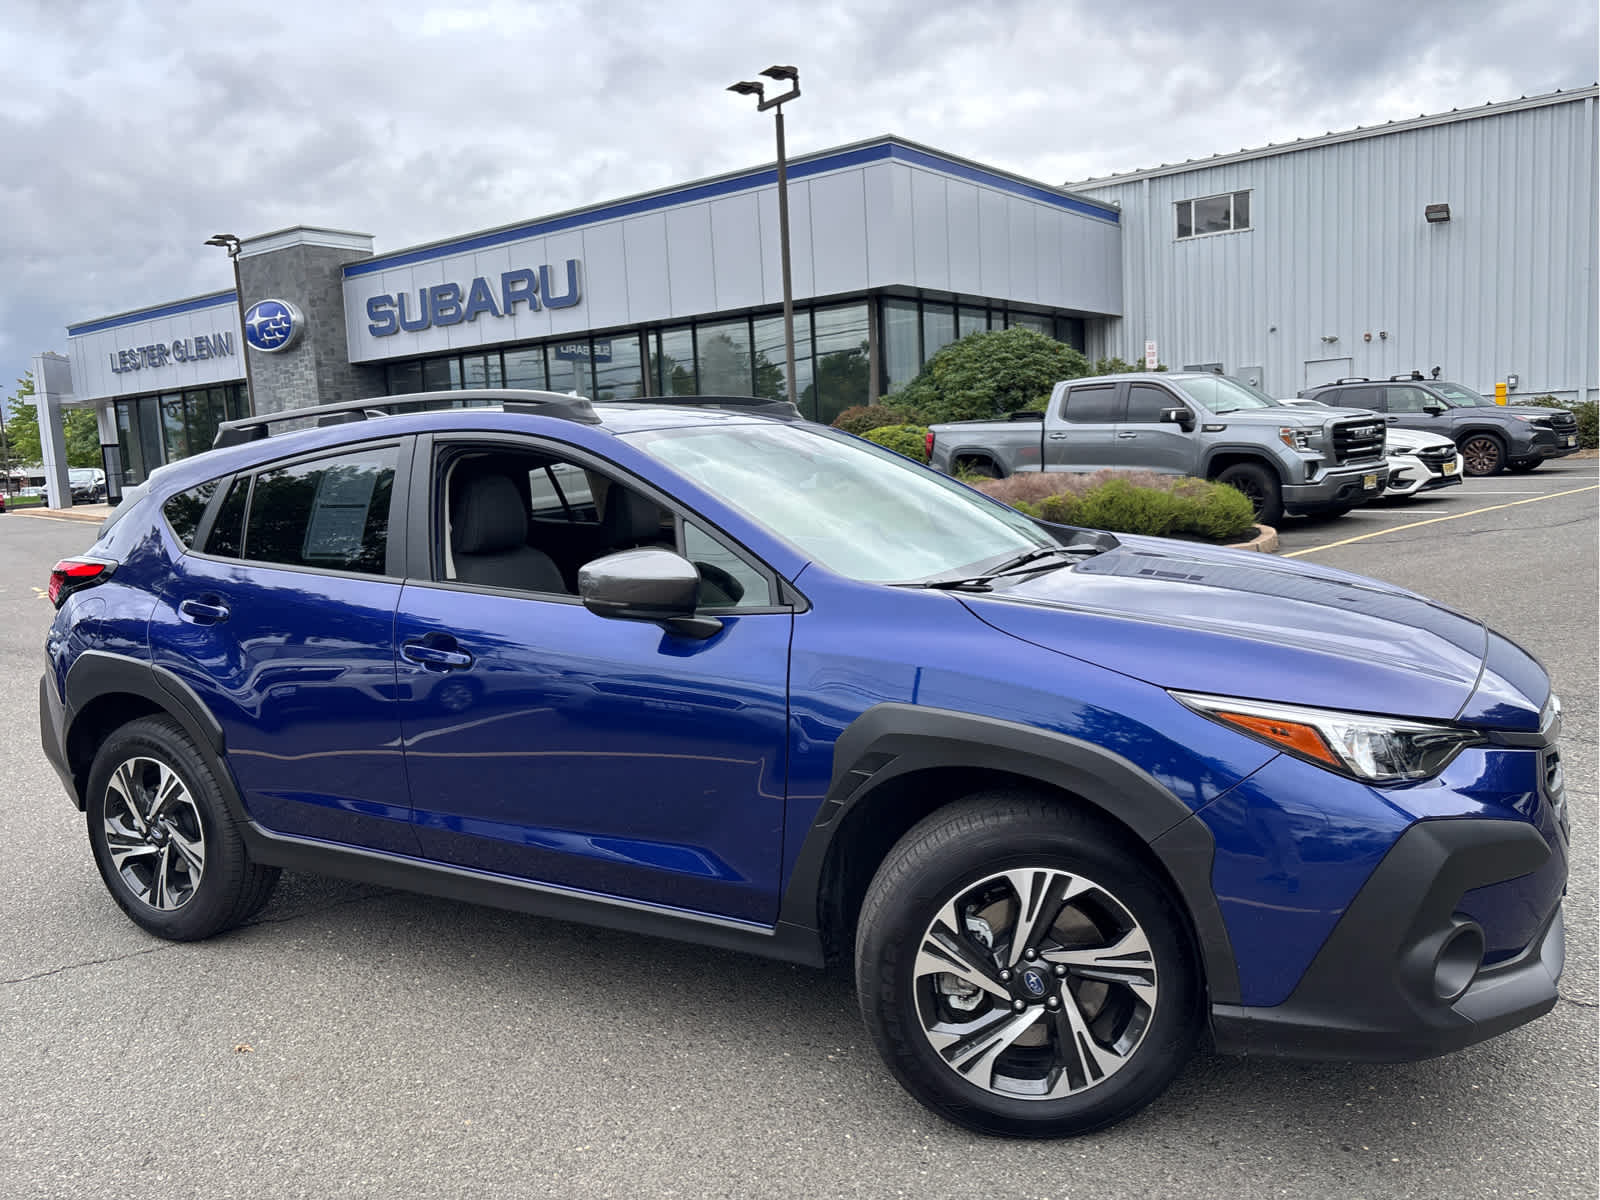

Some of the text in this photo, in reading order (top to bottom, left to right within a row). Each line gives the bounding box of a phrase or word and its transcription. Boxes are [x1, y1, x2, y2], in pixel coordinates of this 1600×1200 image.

[366, 259, 581, 337] SUBARU
[110, 331, 234, 374] LESTER GLENN
